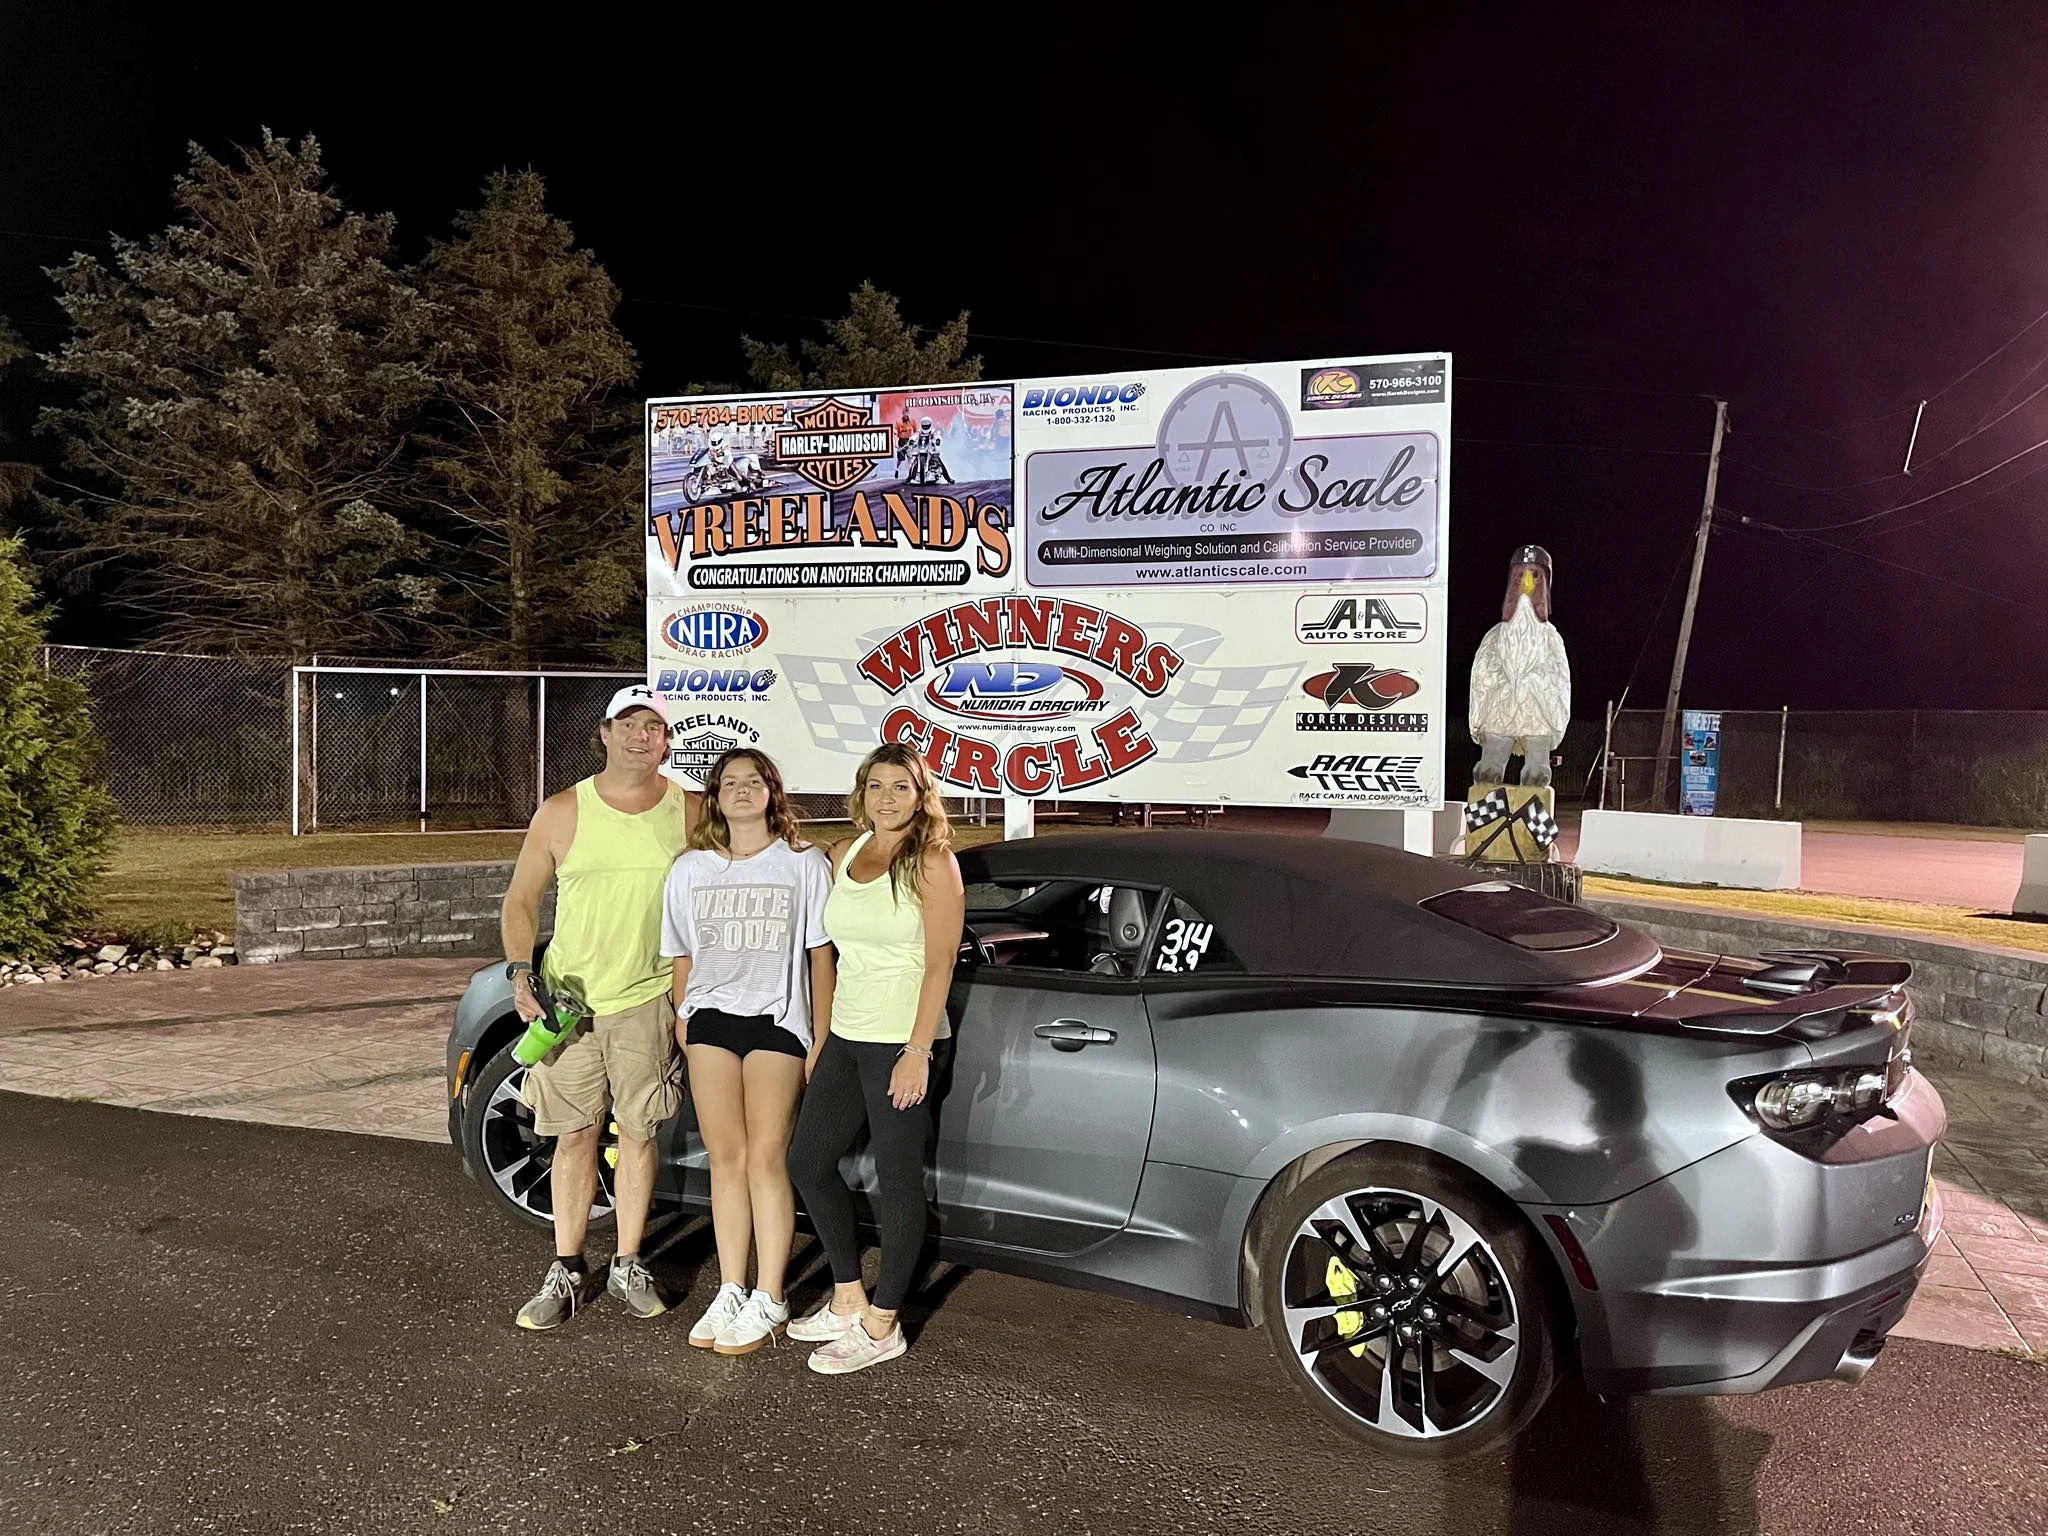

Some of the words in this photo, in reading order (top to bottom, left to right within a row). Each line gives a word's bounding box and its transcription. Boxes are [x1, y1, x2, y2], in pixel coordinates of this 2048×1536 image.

[1369, 375, 1442, 389] 570-966-3100
[1022, 384, 1143, 408] BIONDO
[656, 404, 785, 429] 570-784-BIKE
[805, 405, 861, 429] MOTOR
[1022, 409, 1057, 417] RACING
[1062, 406, 1115, 415] PRODUCTS,
[1047, 414, 1116, 425] 1-800-332-1320
[781, 432, 887, 456] HARLEY-DAVIDSON
[806, 458, 865, 485] CYCLES
[1040, 456, 1266, 520] Atlantic
[1278, 444, 1426, 514] Scale
[652, 491, 1012, 578] VREELAND'S
[1200, 524, 1215, 533] CO
[1043, 547, 1051, 559] A
[1053, 544, 1142, 559] Multi-Dimensional
[1144, 543, 1192, 559] Weighing
[1194, 542, 1237, 555] Solution
[1240, 541, 1260, 553] and
[1324, 538, 1366, 552] Service
[1369, 536, 1417, 550] Provider
[693, 565, 800, 585] CONGRATULATIONS
[801, 565, 820, 583] ON
[820, 563, 873, 583] ANOTHER
[876, 561, 965, 582] CHAMPIONSHIP
[1136, 564, 1307, 578] www.atlanticscale.com
[677, 603, 752, 617] CHAMPIONSHIP
[679, 613, 753, 649] NHRA
[1353, 631, 1407, 639] STORE
[679, 646, 706, 658] DRAG
[711, 645, 751, 659] RACING
[857, 596, 1184, 697] WINNERS
[656, 669, 775, 692] BIONDO
[695, 694, 746, 702] PRODUCTS,
[959, 700, 1025, 711] NUMIDIA
[1029, 700, 1110, 712] DRAGWAY
[670, 714, 760, 743] REELAND'S
[957, 723, 1076, 733] www.numidiadragway.com
[1297, 713, 1347, 724] KOREK
[1357, 714, 1428, 725] DESIGNS
[691, 739, 731, 749] MOTOR
[880, 706, 1158, 795] CIRCLE
[676, 752, 720, 764] HARLEY-DA
[1309, 755, 1402, 772] RACE
[1309, 773, 1402, 791] TECH
[1299, 792, 1320, 800] RACE
[693, 887, 791, 921] WHITE
[724, 920, 787, 951] OUT
[1161, 919, 1213, 955] 314
[1156, 950, 1199, 973] 12.9
